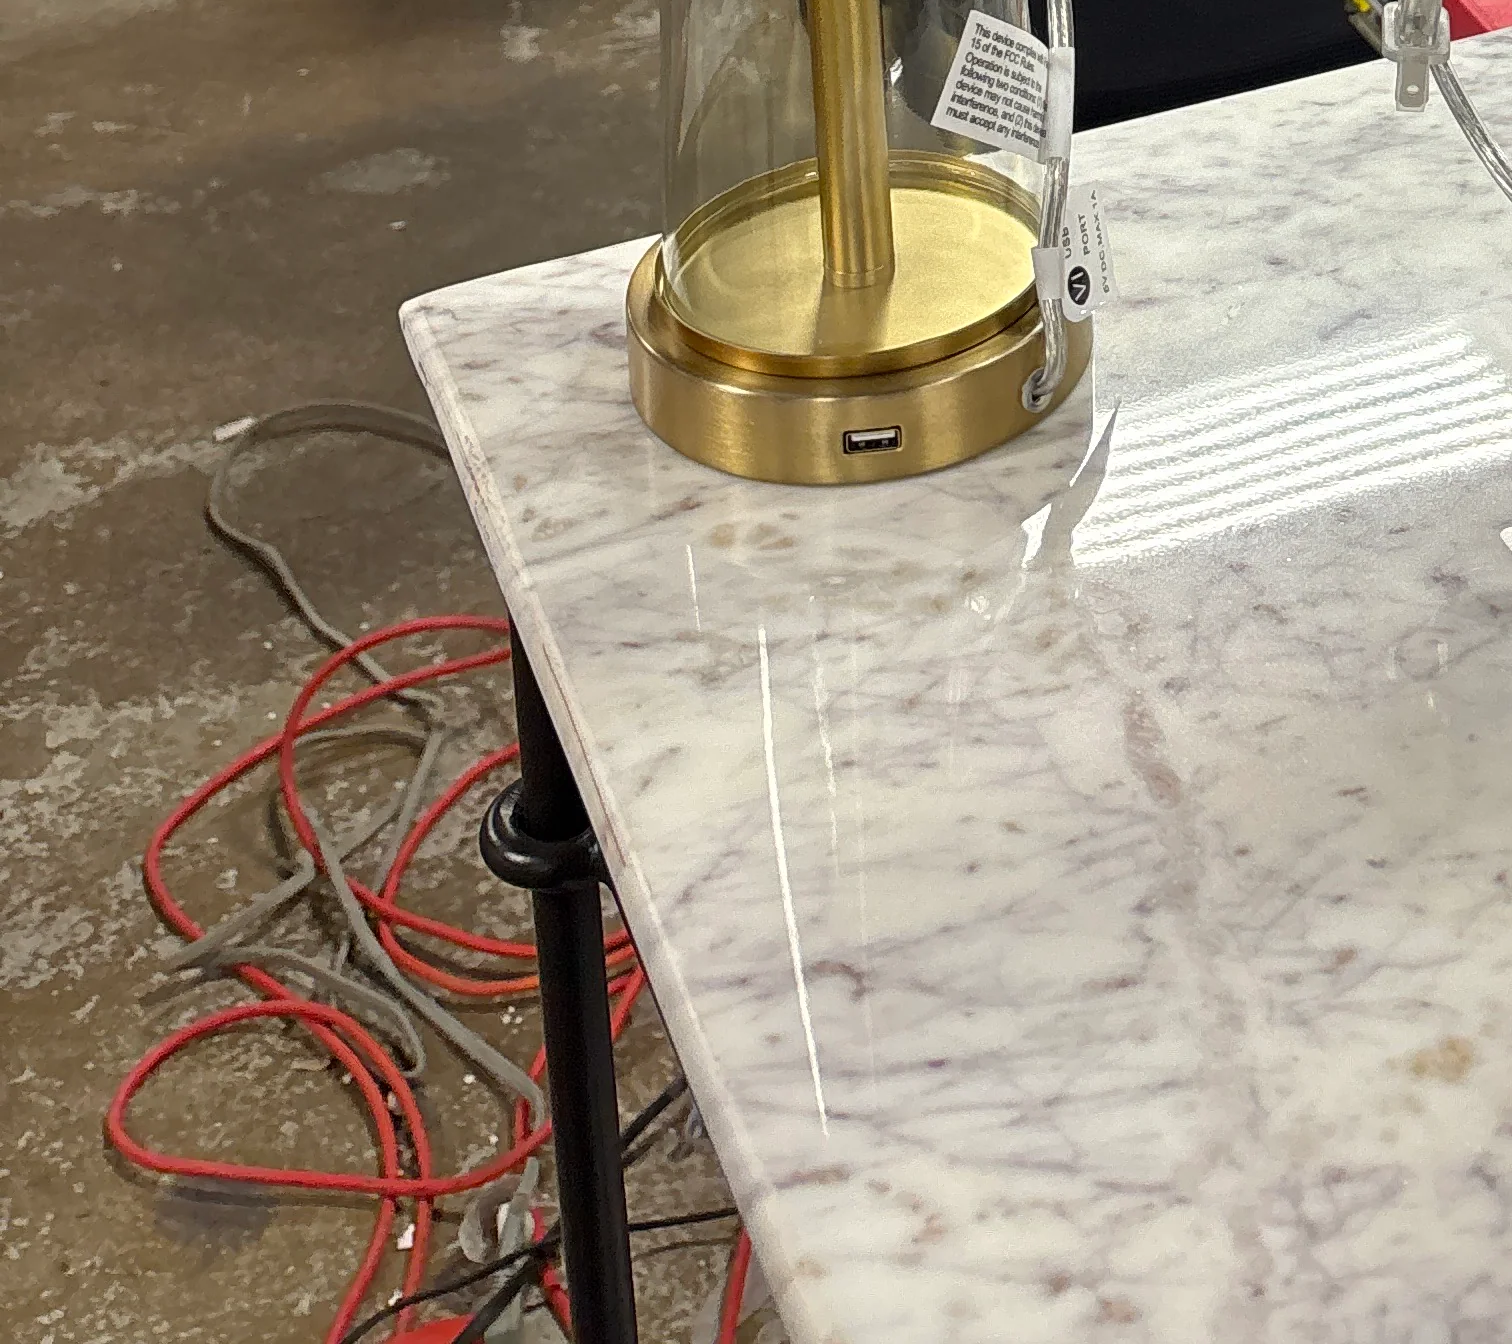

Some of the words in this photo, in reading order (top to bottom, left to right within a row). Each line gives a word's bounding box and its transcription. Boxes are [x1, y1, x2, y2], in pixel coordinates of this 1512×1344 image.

[971, 36, 982, 50] 15
[982, 42, 993, 53] of
[992, 44, 1003, 58] the
[1004, 49, 1020, 65] FCC
[976, 23, 991, 39] This
[992, 30, 1015, 49] device
[960, 64, 995, 89] following
[996, 77, 1009, 92] two
[965, 51, 1003, 75] Operation
[1003, 64, 1010, 78] is
[955, 78, 983, 97] device
[984, 89, 1001, 106] may
[1002, 96, 1014, 109] not
[946, 105, 969, 123] must
[970, 113, 996, 132] accept
[997, 123, 1011, 139] any
[1001, 110, 1015, 123] and
[1062, 226, 1072, 259] USB
[1078, 213, 1090, 256] PORT
